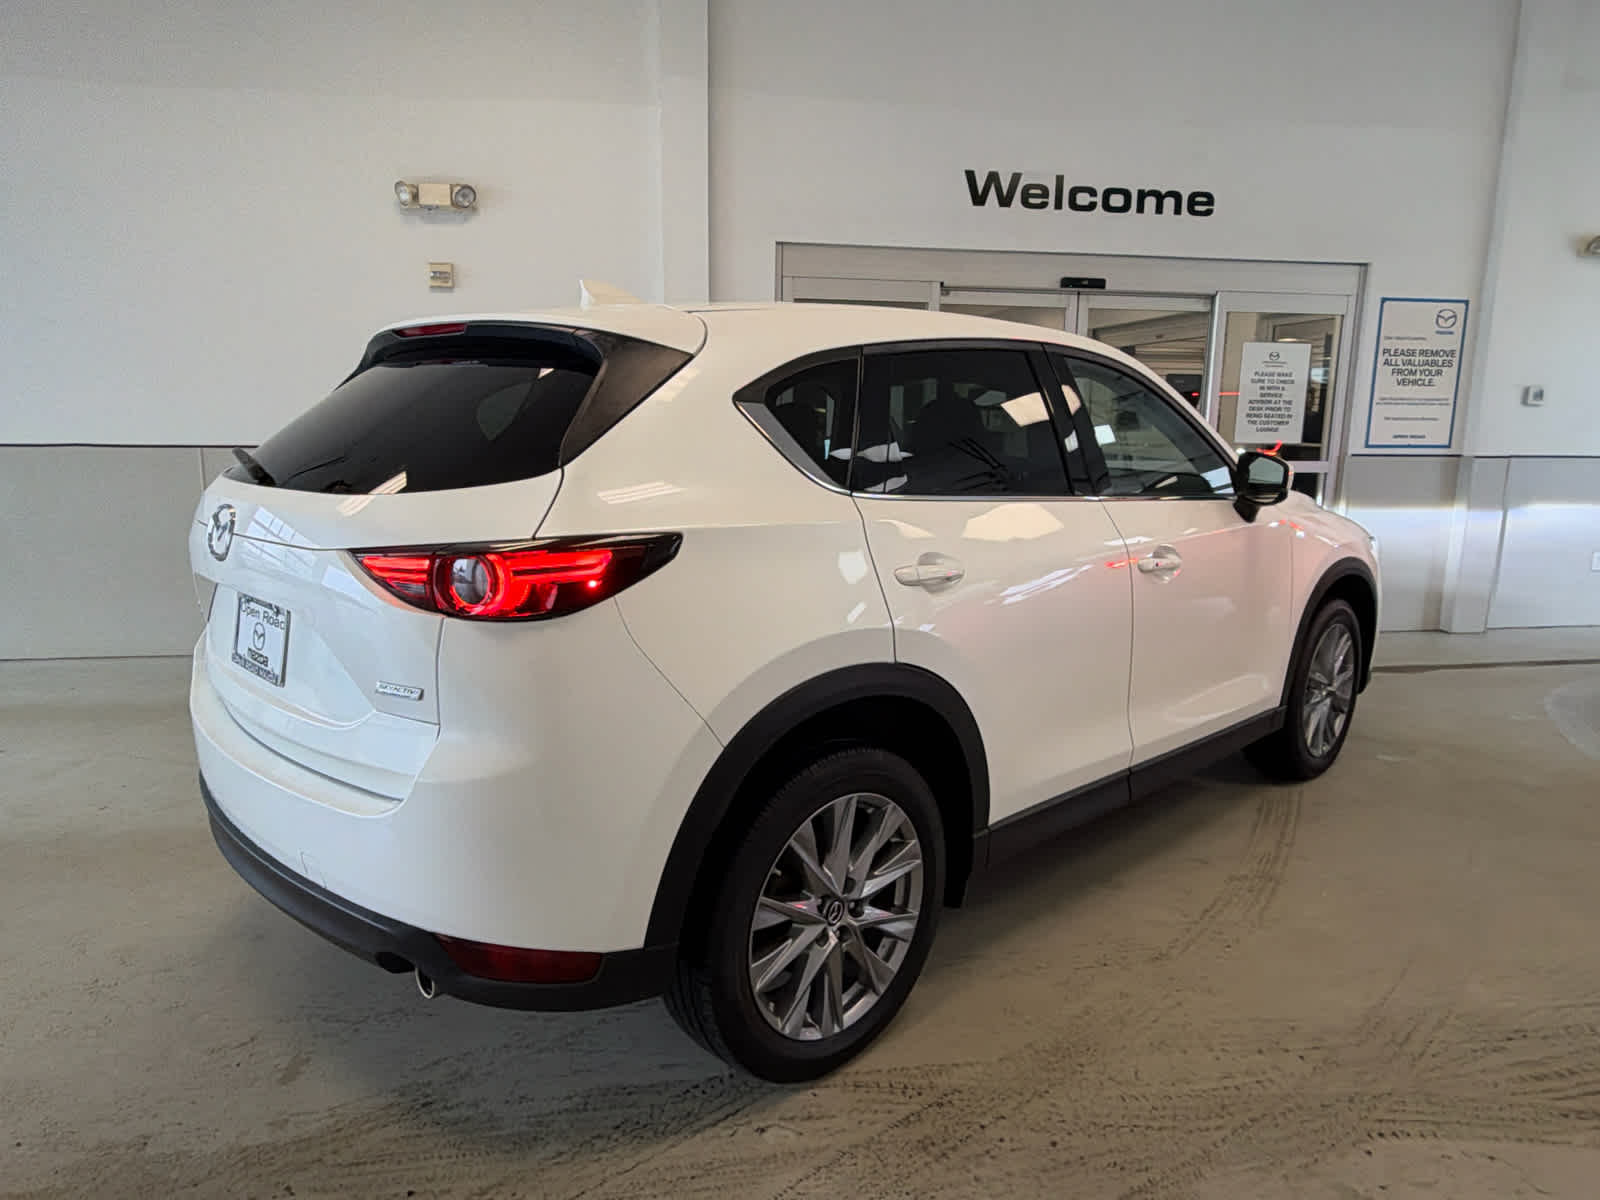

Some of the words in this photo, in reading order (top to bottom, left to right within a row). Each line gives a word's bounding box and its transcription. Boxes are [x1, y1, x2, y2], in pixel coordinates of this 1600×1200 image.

[965, 169, 1215, 217] Welcome
[1382, 348, 1417, 357] PLEASE
[1418, 349, 1456, 358] REMOVE
[1383, 358, 1400, 367] ALL
[1401, 358, 1454, 368] VALUABLES
[1392, 368, 1417, 377] FROM
[1419, 368, 1443, 377] YOUR
